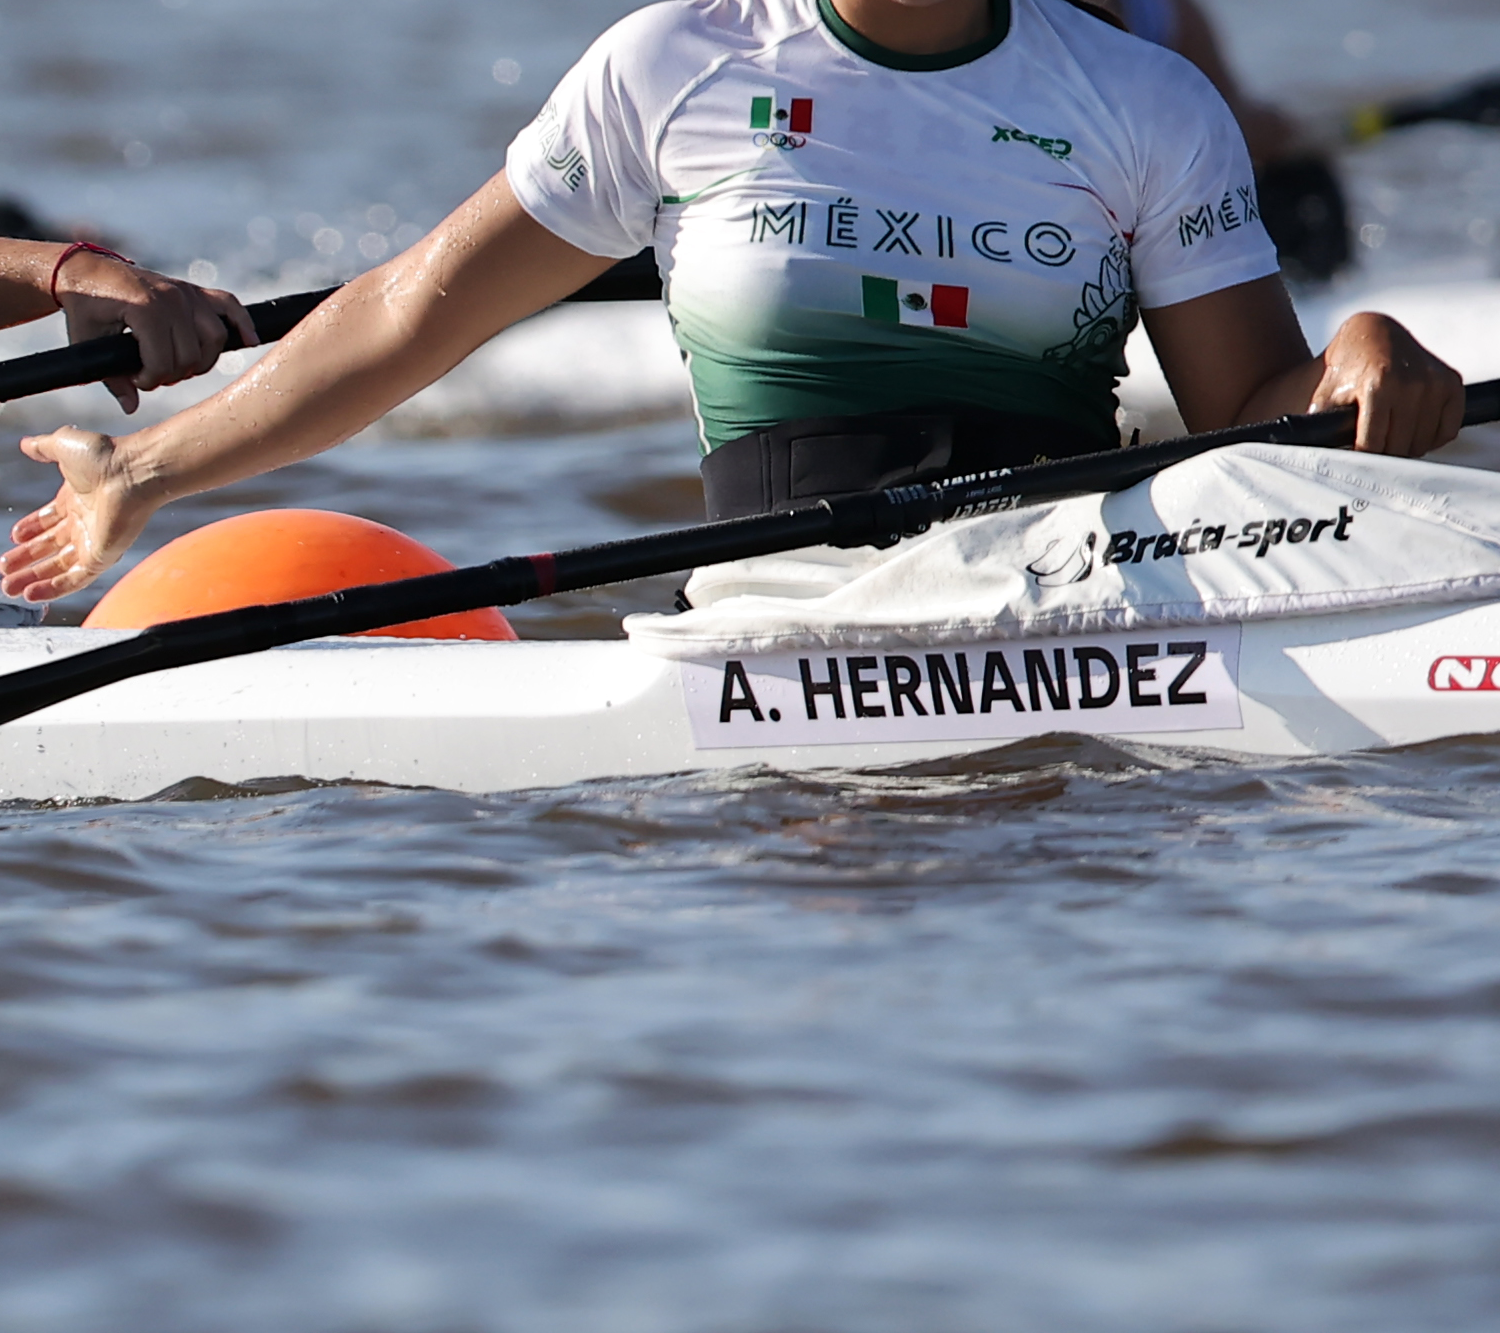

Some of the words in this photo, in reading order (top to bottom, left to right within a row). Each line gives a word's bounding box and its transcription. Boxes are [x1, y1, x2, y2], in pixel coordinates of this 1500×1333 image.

[719, 659, 781, 723] A.
[799, 640, 1207, 720] HERNANDEZ
[1430, 655, 1500, 691] N
